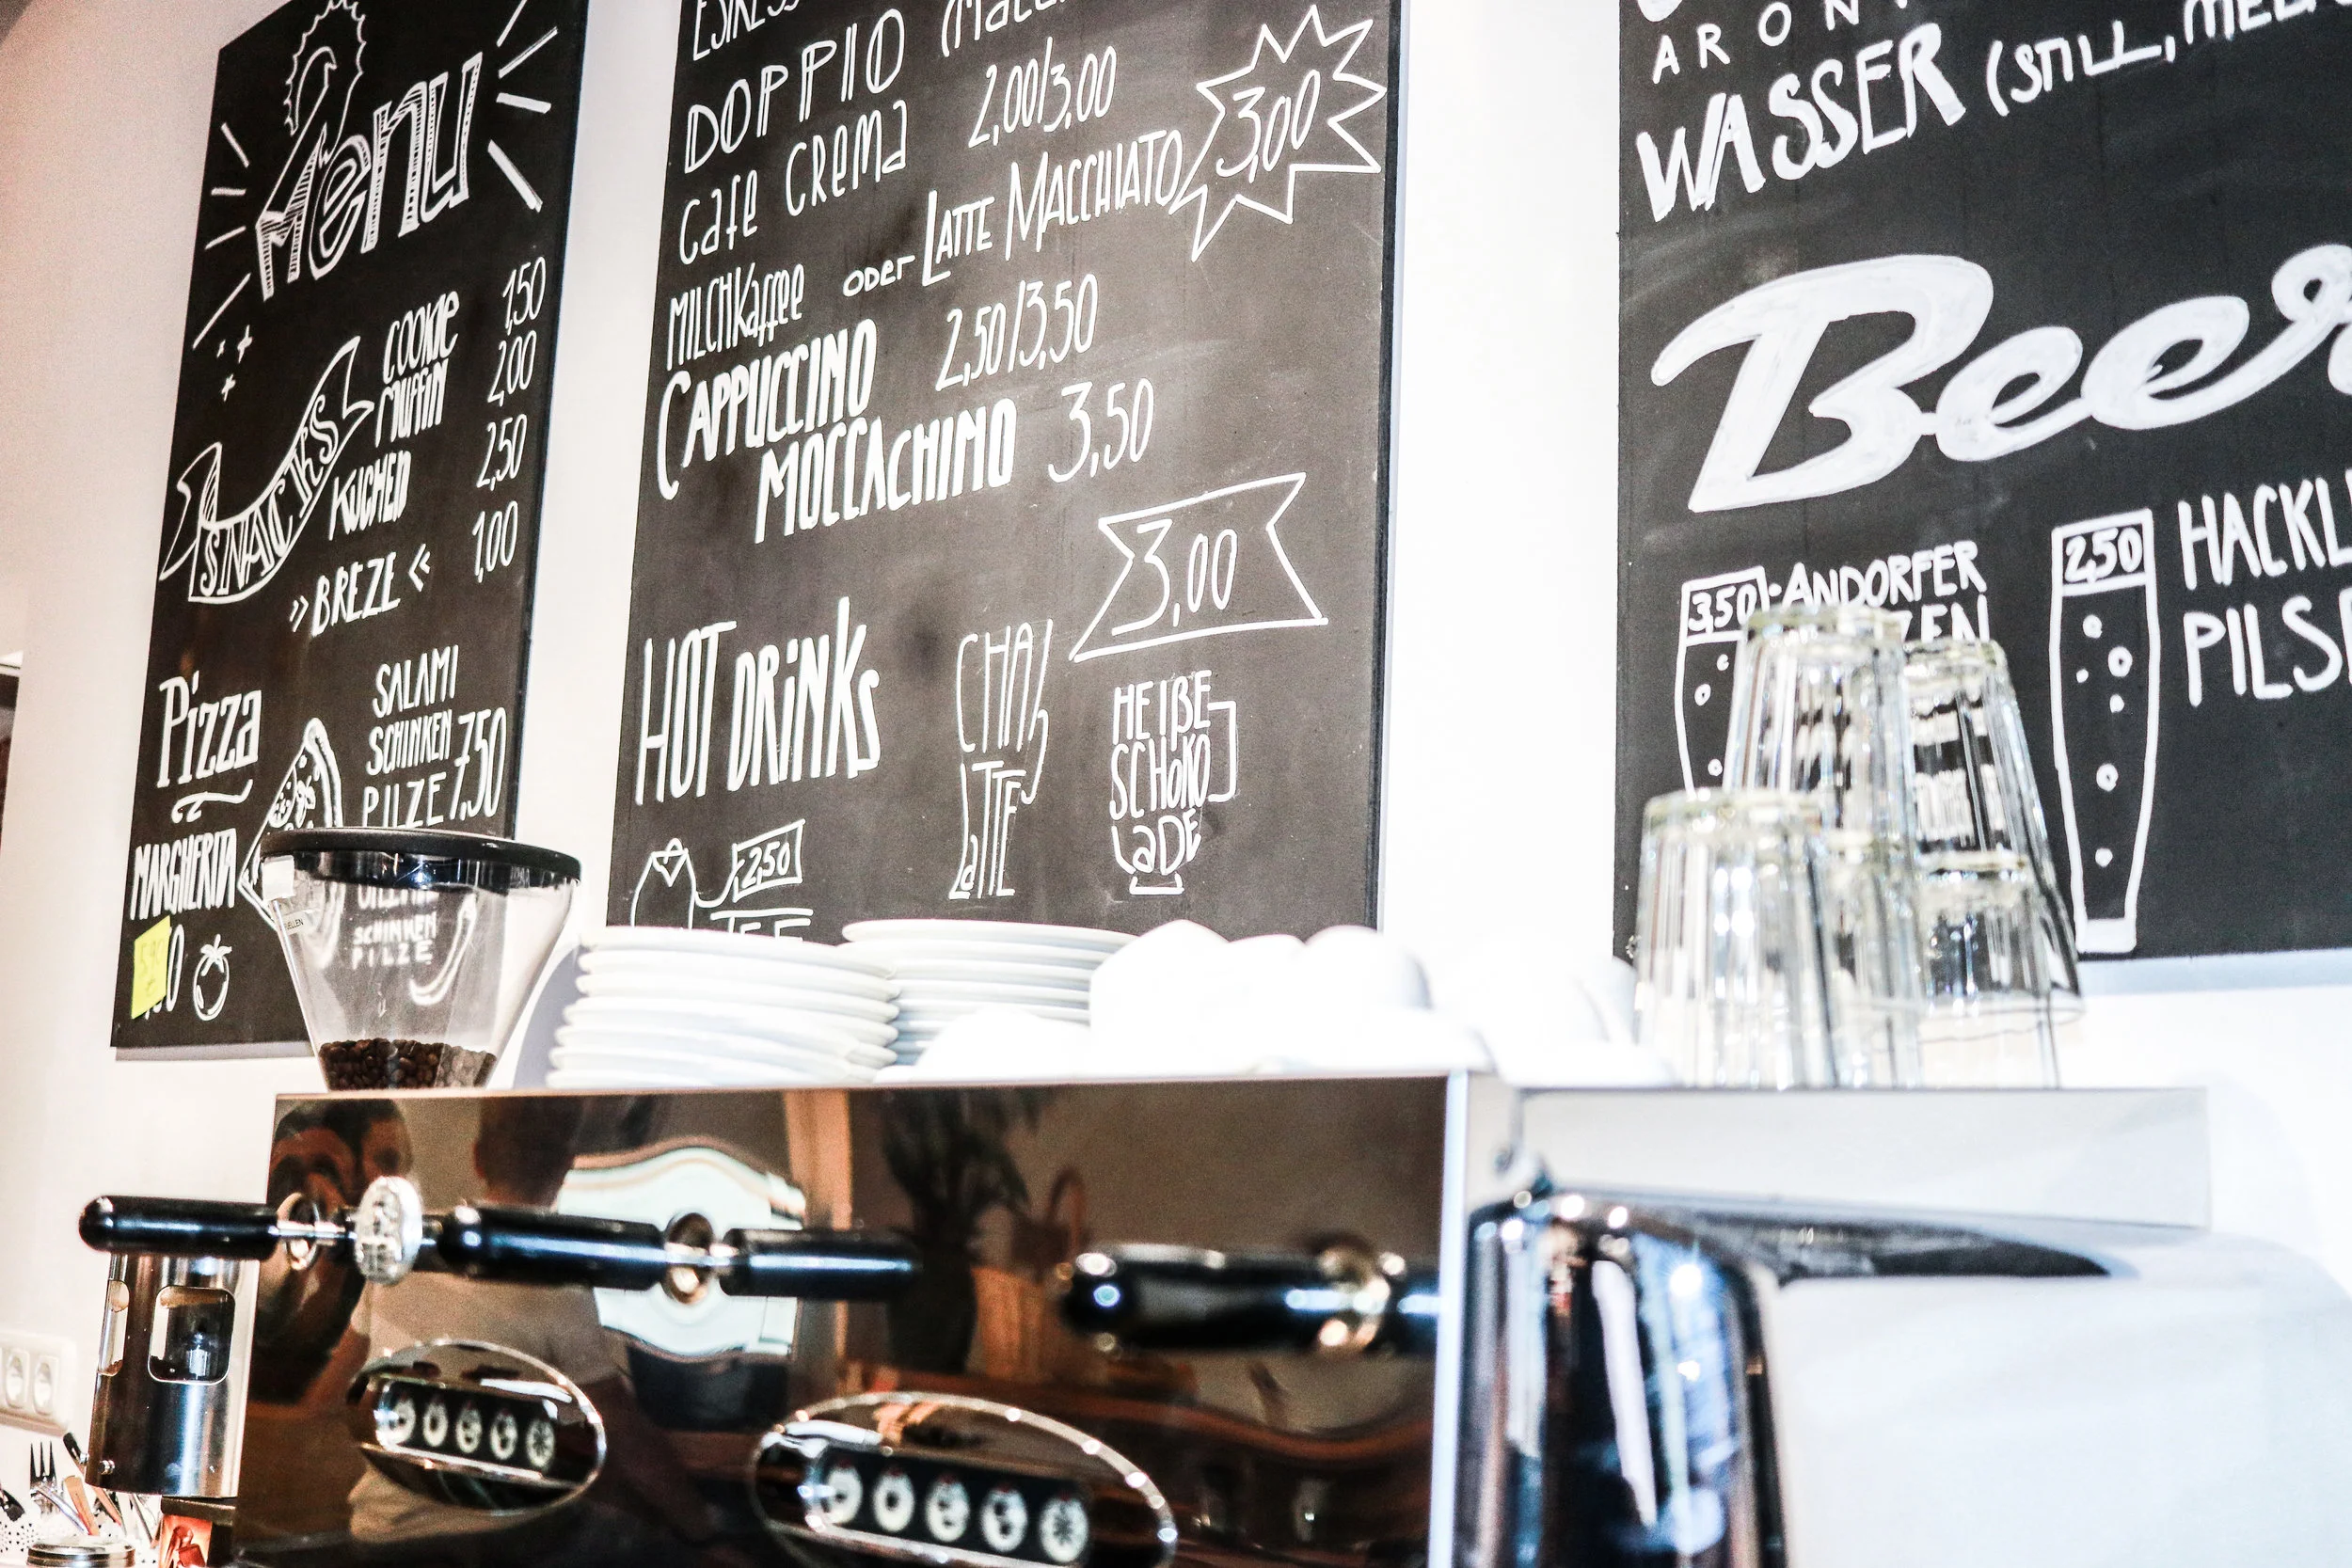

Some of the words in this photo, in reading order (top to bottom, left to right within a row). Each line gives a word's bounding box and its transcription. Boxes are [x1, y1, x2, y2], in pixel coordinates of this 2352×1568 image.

[685, 9, 905, 173] DOPPIO
[1216, 70, 1321, 183] 3,00
[1636, 23, 1966, 222] WASSER
[254, 52, 483, 302] Menu
[679, 170, 758, 264] Cafe
[1005, 130, 1184, 261] MACCHIATO
[657, 318, 877, 500] CAPPUCCINO
[755, 398, 1017, 544] MOCCACHINO
[1048, 378, 1155, 483] 3,50
[200, 394, 339, 596] SNACKS
[329, 450, 411, 541] KUCHEN
[476, 414, 527, 491] 2,50
[2178, 468, 2352, 591] HACKL
[1111, 518, 1238, 636] 3,00
[372, 644, 459, 719] SALAMI
[956, 619, 1053, 753] CHAI
[2183, 587, 2352, 706] PILS
[156, 670, 262, 788] Pizza
[366, 708, 453, 776] SCHINKEN
[635, 620, 738, 806] HOT
[361, 771, 447, 828] PILZE
[130, 828, 237, 921] MARGHERITA
